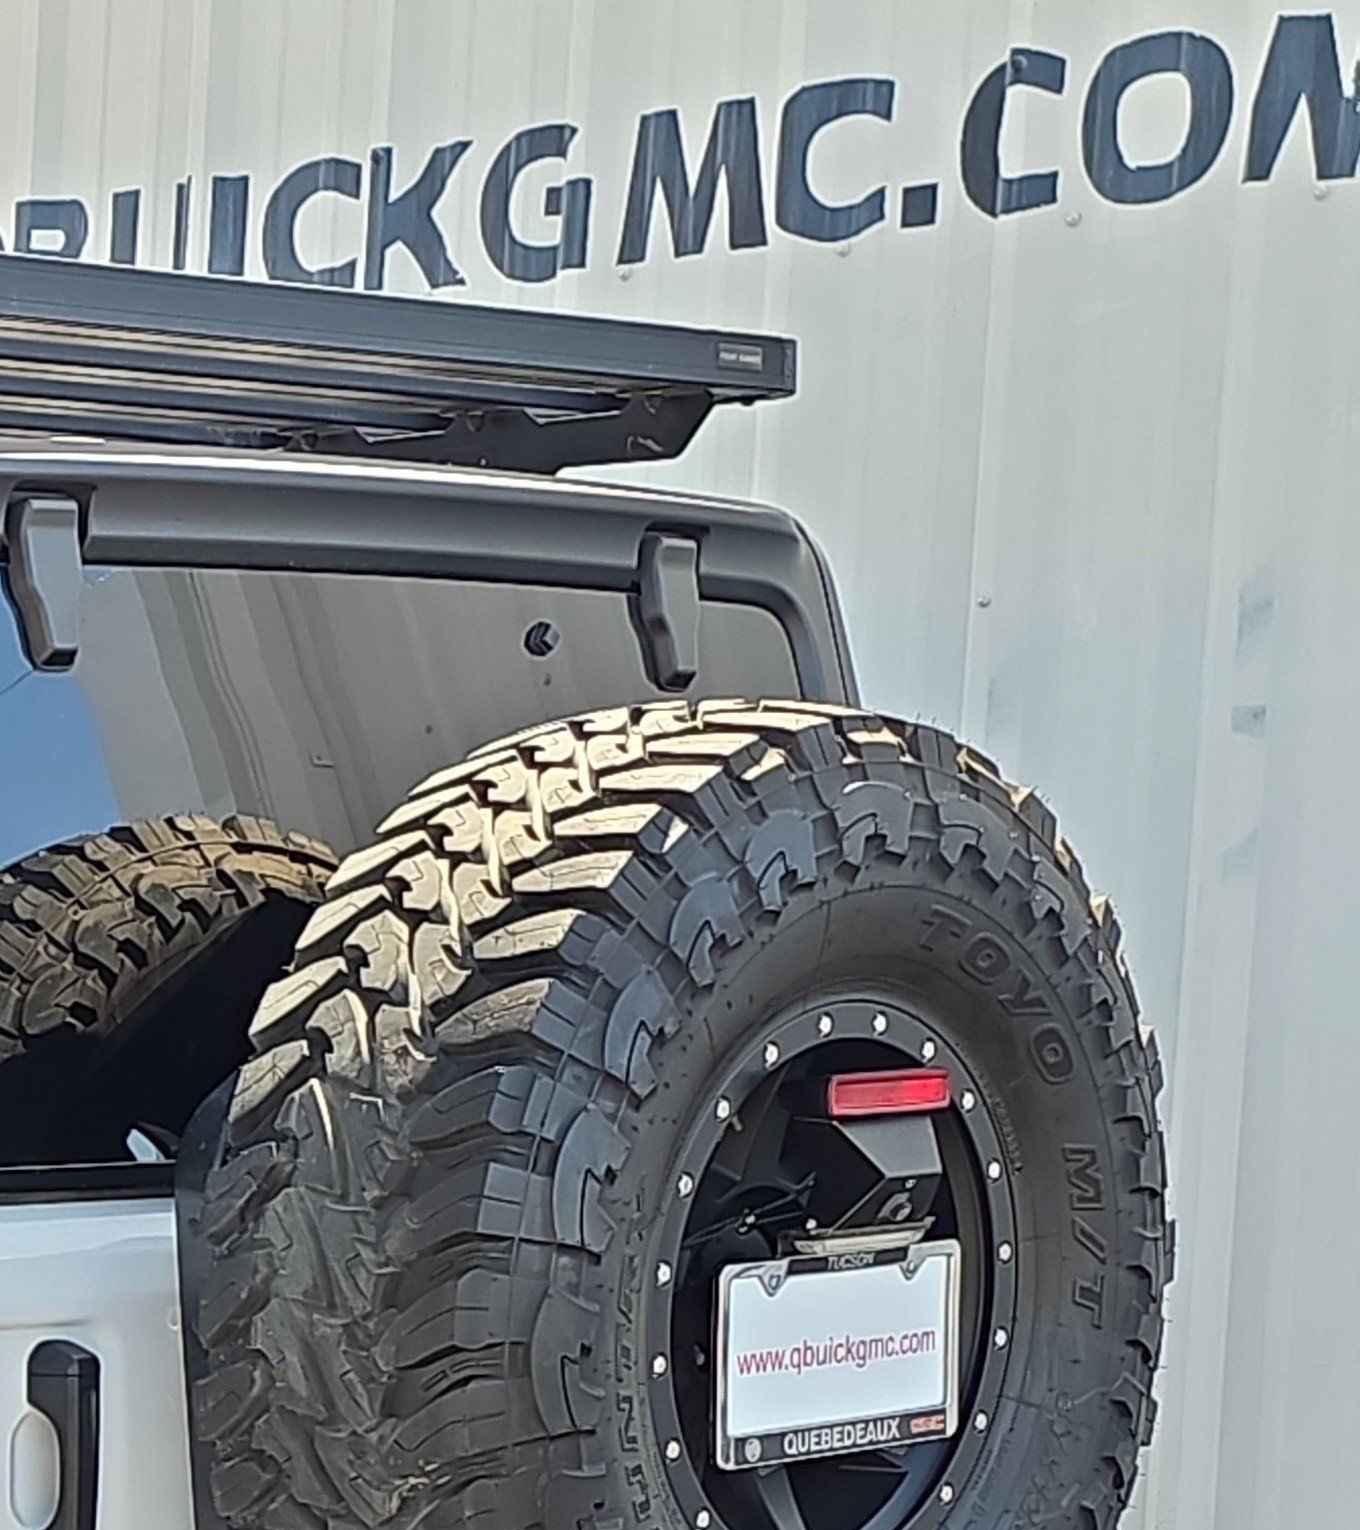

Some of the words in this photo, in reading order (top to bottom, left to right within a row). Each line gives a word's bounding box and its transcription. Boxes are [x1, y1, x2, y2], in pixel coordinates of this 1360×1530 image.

[918, 902, 1076, 1085] TOYO
[1062, 1143, 1108, 1331] M/T
[828, 1252, 877, 1271] TUCSON
[736, 1329, 936, 1376] www.qbuickgmc.com
[783, 1417, 901, 1455] QUEBEDEAUX
